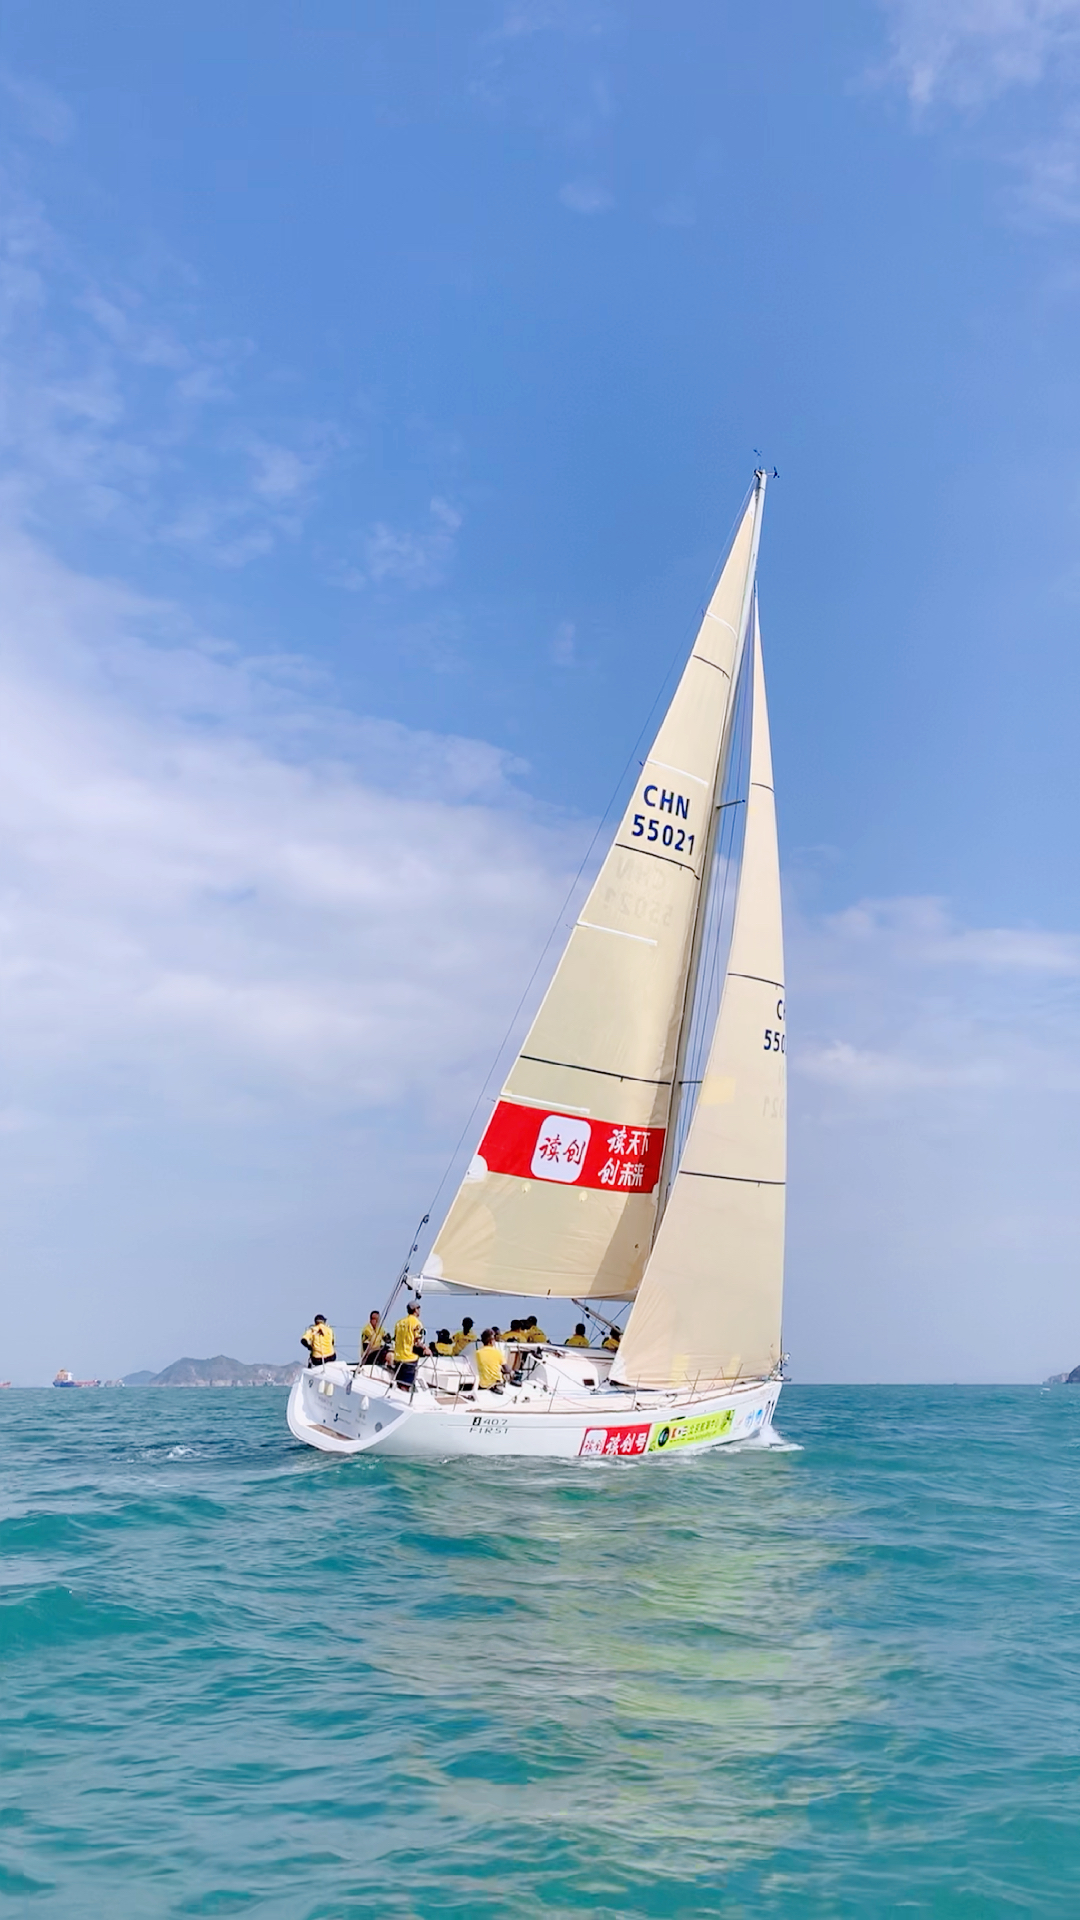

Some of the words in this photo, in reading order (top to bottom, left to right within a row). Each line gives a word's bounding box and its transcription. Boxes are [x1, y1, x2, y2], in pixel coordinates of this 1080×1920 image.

[643, 784, 691, 820] CHN
[631, 813, 695, 856] 55021
[538, 1133, 587, 1166] 读创
[607, 1125, 652, 1157] 读天下
[598, 1157, 645, 1187] 创未来
[483, 1418, 508, 1426] 407
